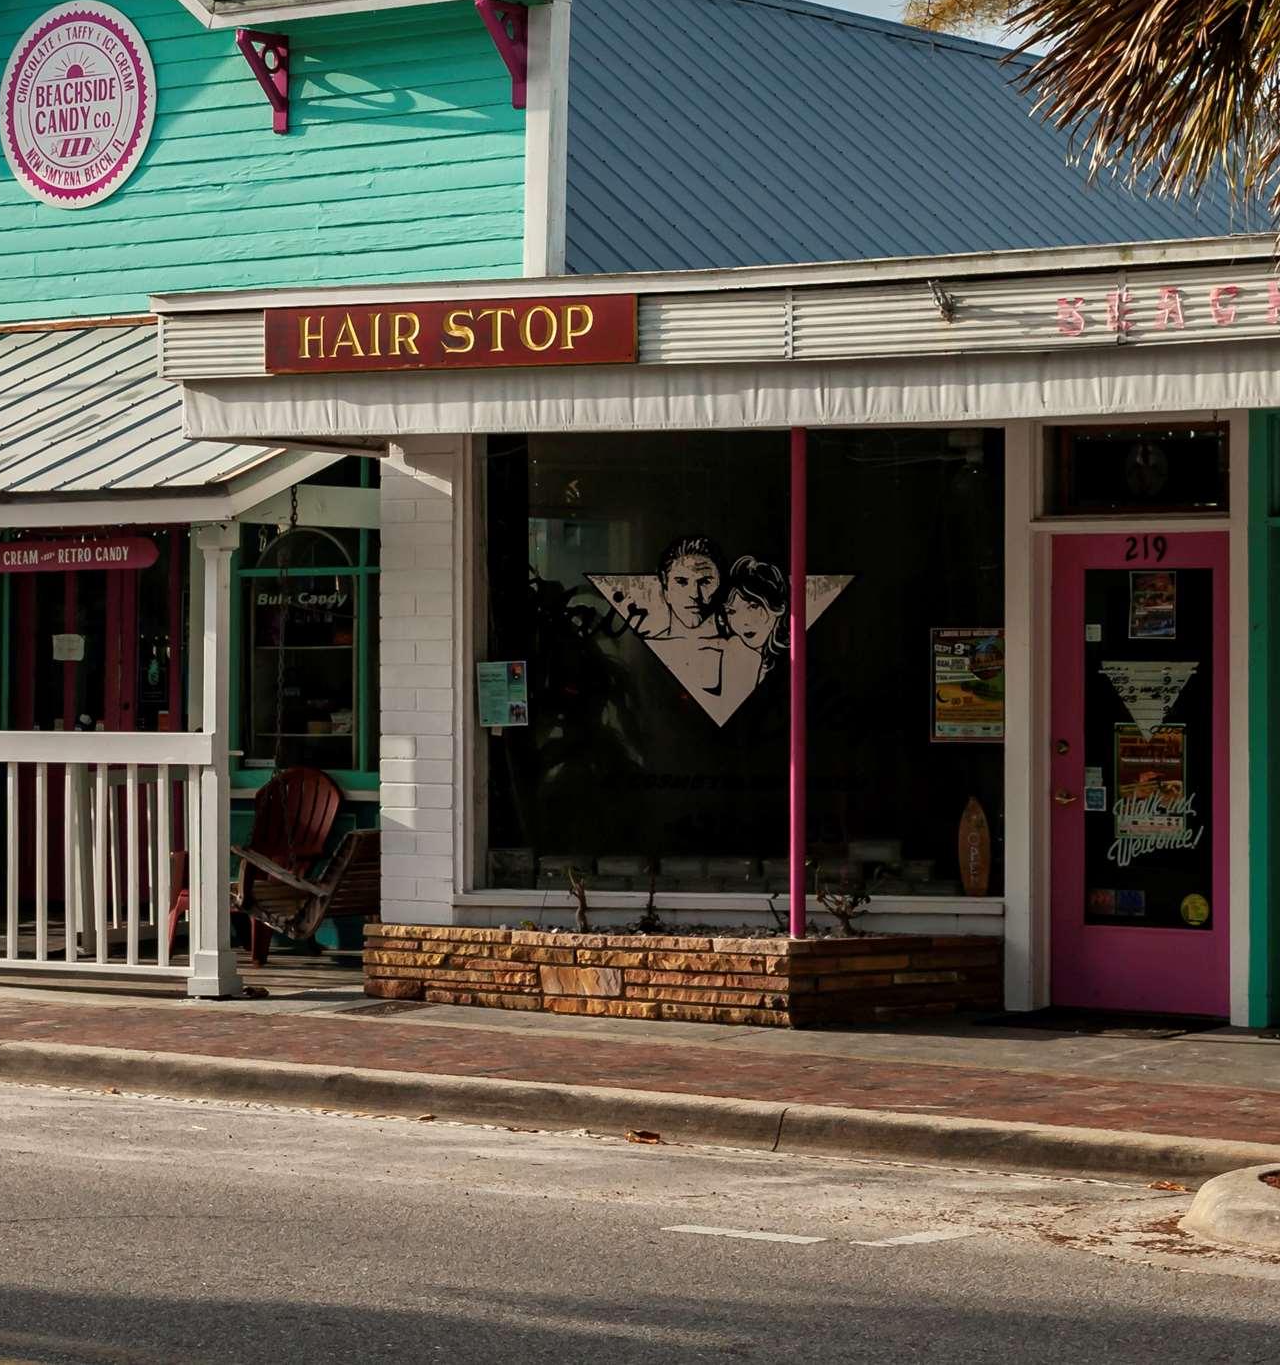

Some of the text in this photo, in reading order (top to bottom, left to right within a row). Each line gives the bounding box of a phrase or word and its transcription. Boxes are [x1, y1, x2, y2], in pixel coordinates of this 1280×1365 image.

[16, 25, 136, 103] CHOCOLATE TAFFY ICE CREAM
[35, 77, 117, 109] BEACHSIDE
[34, 105, 91, 136] CANDY
[24, 147, 43, 173] NEW
[42, 165, 82, 187] SMYRNA
[111, 138, 126, 154] FL
[298, 303, 595, 360] HAIR STOP
[3, 549, 39, 566] CREAM
[57, 547, 92, 564] RETRO
[95, 545, 130, 562] CANDY
[1125, 535, 1168, 564] 219
[297, 591, 348, 609] Candy
[1107, 825, 1204, 867] Welcome!
